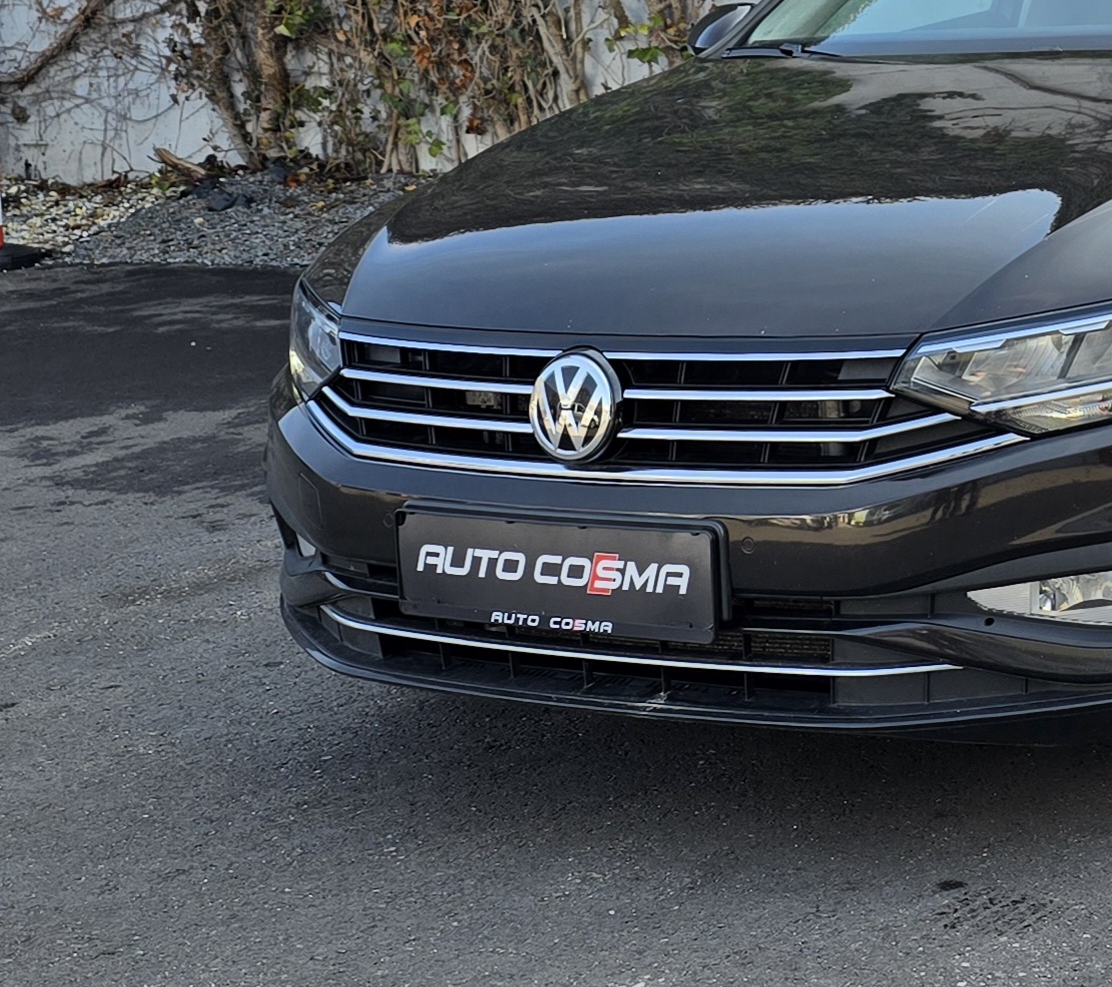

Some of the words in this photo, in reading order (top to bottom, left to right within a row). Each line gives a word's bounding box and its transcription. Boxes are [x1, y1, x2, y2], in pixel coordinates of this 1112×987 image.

[532, 359, 608, 456] VW
[416, 543, 526, 582] AUTO
[533, 554, 691, 594] COSMA
[490, 611, 540, 627] AUTO
[549, 617, 613, 634] COSMA
